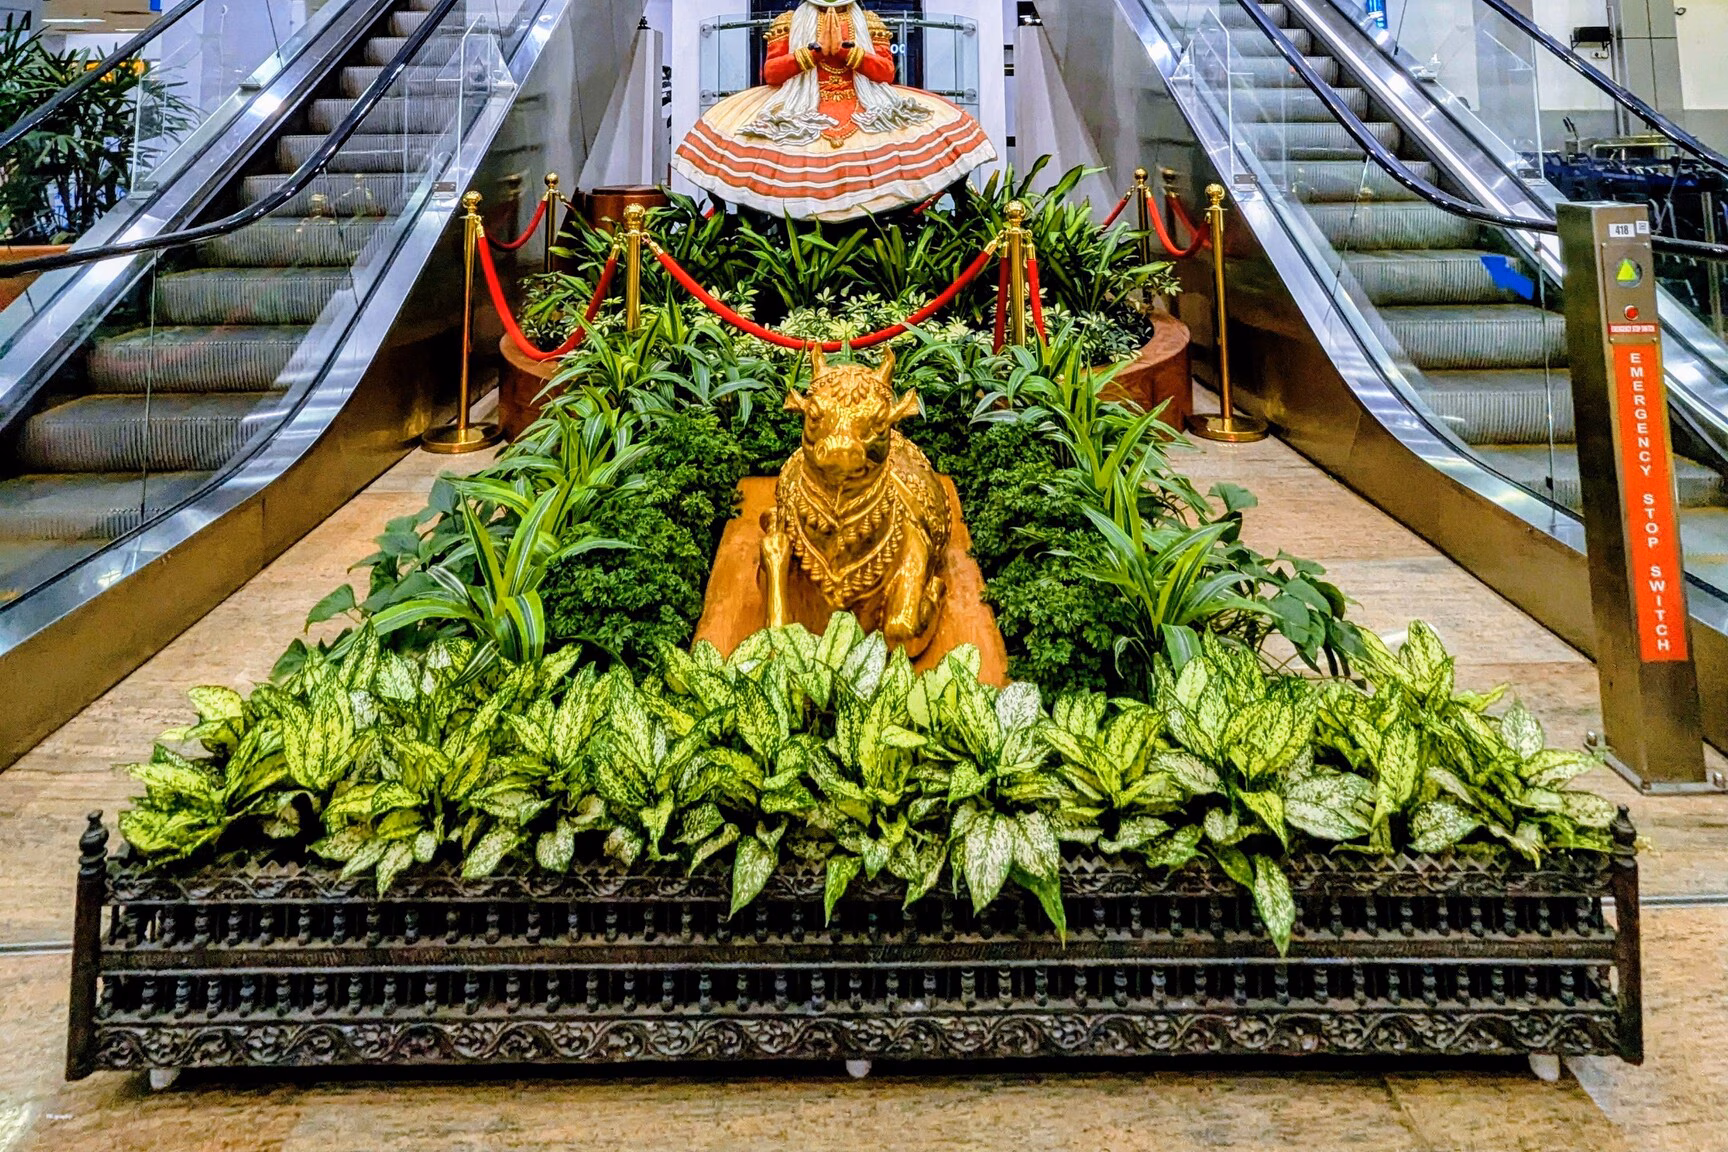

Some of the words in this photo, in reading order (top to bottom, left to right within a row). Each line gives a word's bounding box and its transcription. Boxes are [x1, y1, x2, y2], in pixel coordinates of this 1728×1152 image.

[1615, 224, 1629, 235] 418
[1630, 352, 1652, 476] EMERGENCY
[1643, 493, 1659, 548] STOP
[1649, 565, 1669, 651] SWITCH
